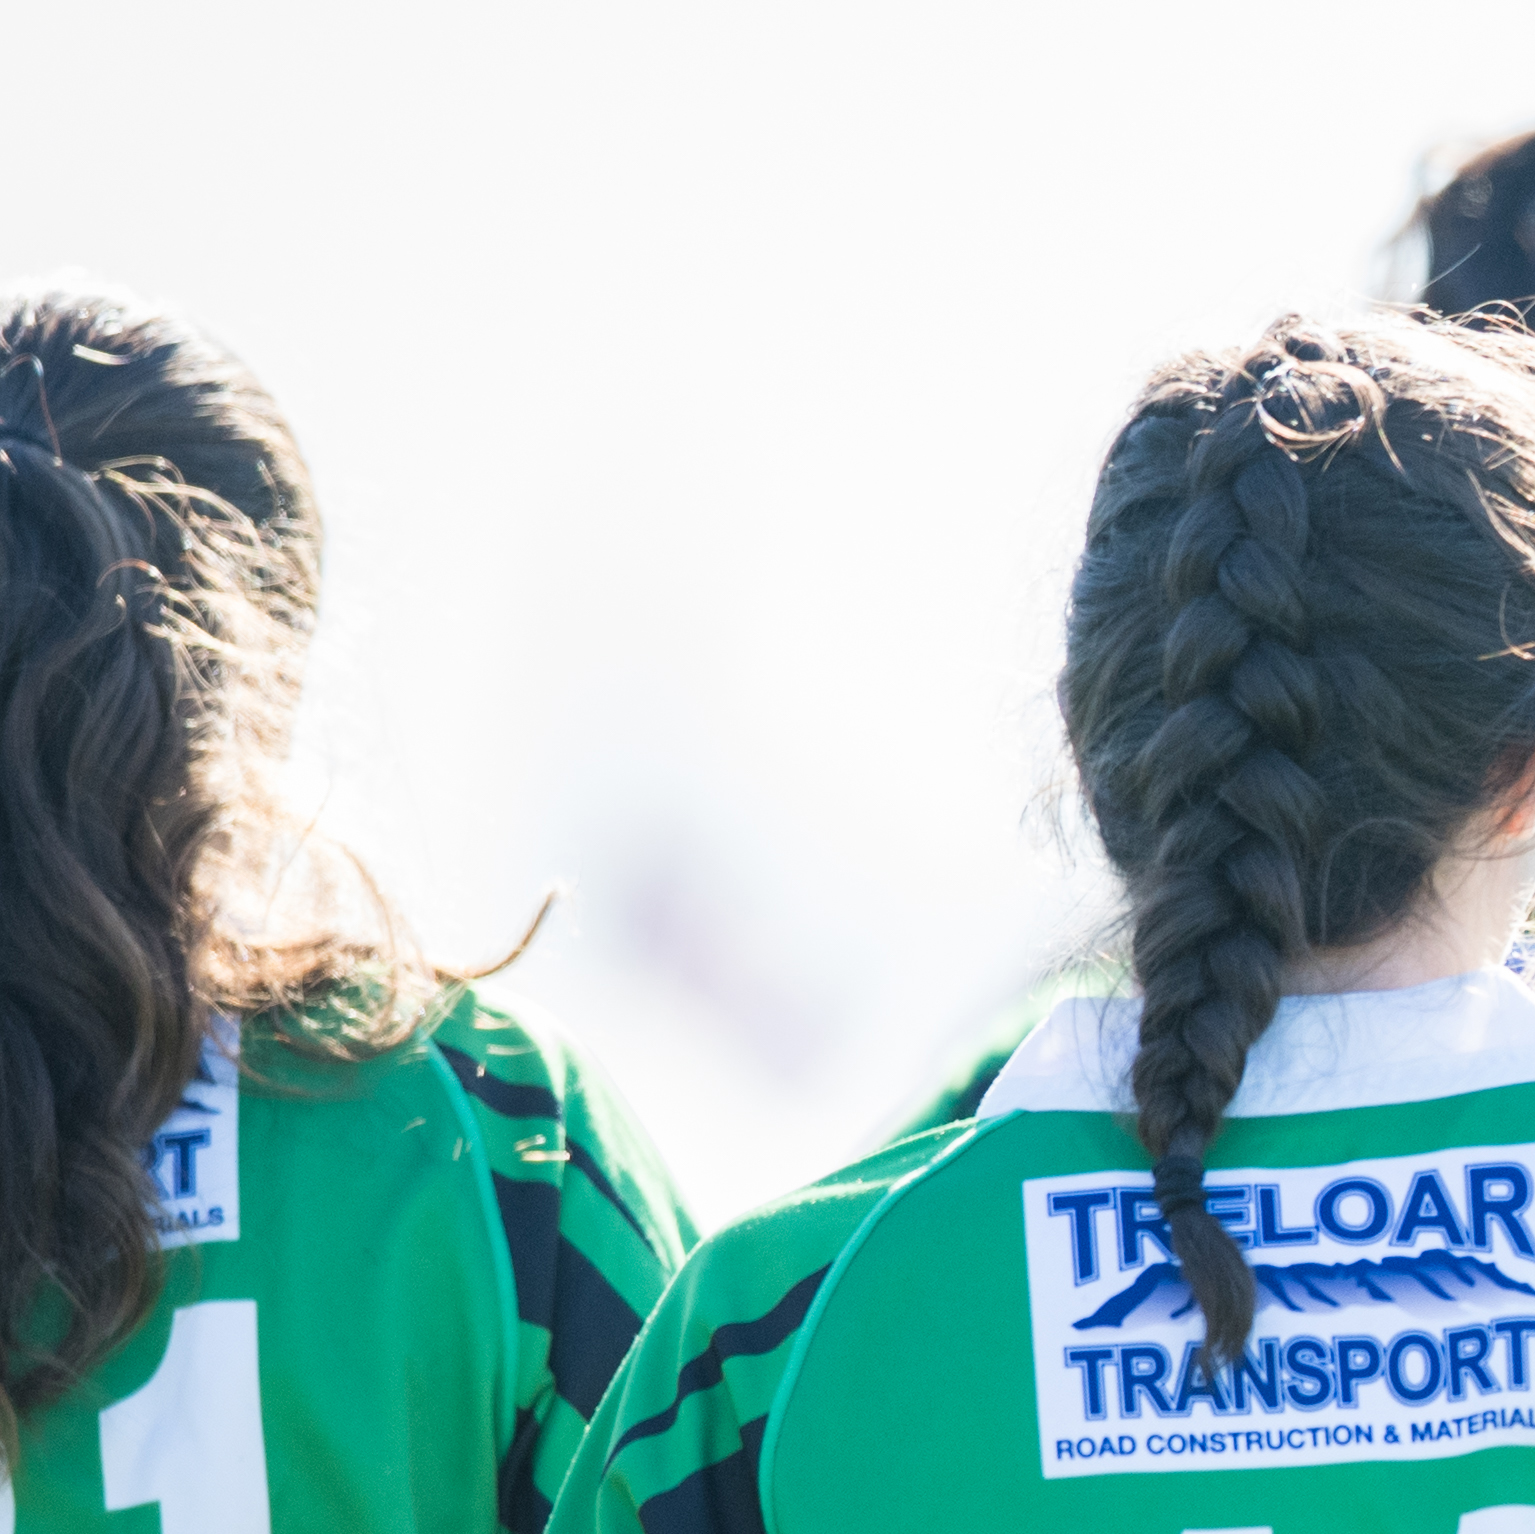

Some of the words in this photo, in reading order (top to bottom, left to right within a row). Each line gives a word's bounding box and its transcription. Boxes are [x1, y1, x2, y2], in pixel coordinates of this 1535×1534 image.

[1056, 1434, 1136, 1460] ROAD
[1146, 1424, 1374, 1454] CONSTRUCTION
[1383, 1424, 1401, 1446] &
